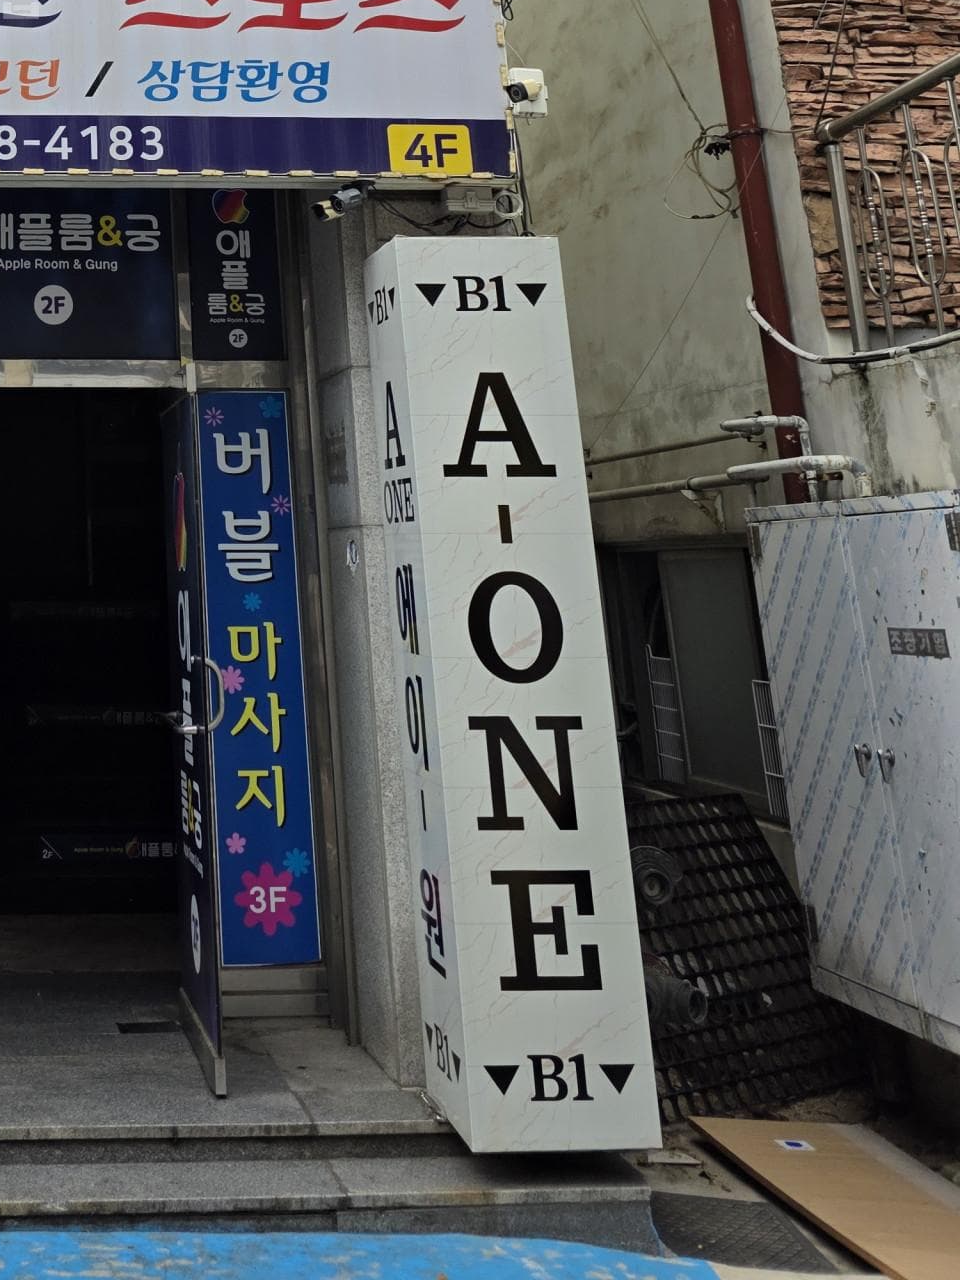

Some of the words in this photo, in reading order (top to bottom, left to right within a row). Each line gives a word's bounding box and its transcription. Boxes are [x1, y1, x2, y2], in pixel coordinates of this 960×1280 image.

[137, 59, 330, 103] 상담환영
[404, 133, 458, 168] 4F
[35, 258, 70, 270] Room
[73, 259, 83, 270] &
[85, 259, 118, 272] Gung
[40, 296, 66, 314] 2F
[375, 285, 389, 326] B1
[452, 275, 511, 312] B1
[384, 380, 406, 470] A
[213, 428, 279, 582] 버블
[383, 477, 415, 525] ONE
[227, 621, 287, 827] 마사지
[249, 886, 287, 914] 3F
[434, 1022, 453, 1082] B1
[527, 1053, 595, 1103] B1
